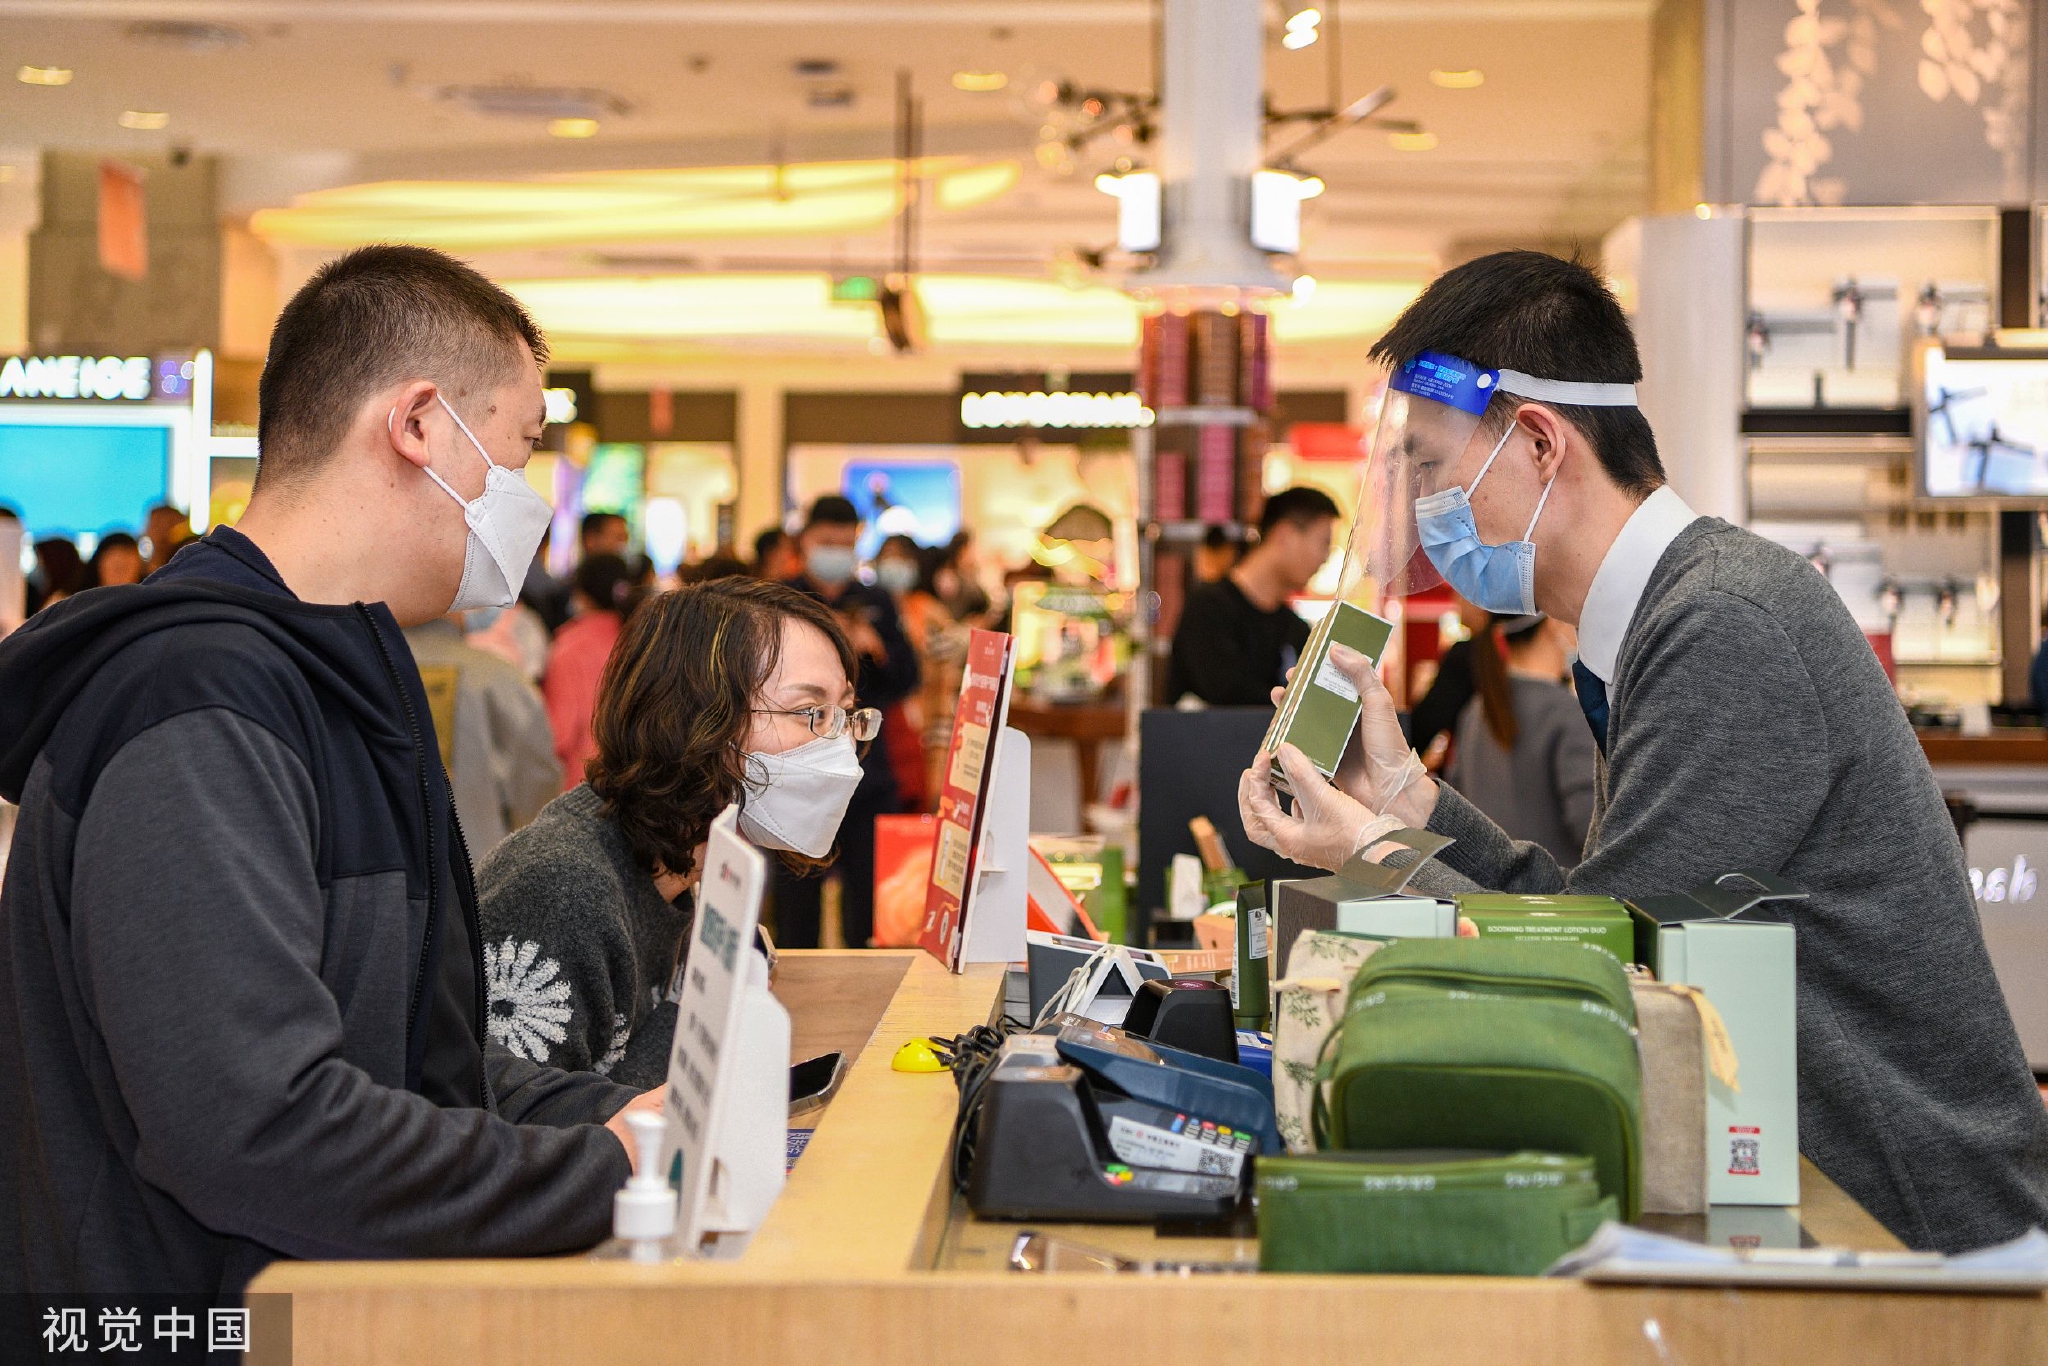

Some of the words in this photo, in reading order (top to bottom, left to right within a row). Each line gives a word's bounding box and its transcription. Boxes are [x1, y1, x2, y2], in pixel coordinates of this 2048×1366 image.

[1487, 925, 1525, 934] SOOTHING
[1525, 925, 1562, 934] TREATMENT
[1564, 926, 1589, 935] LOTION
[1590, 926, 1607, 935] DUO
